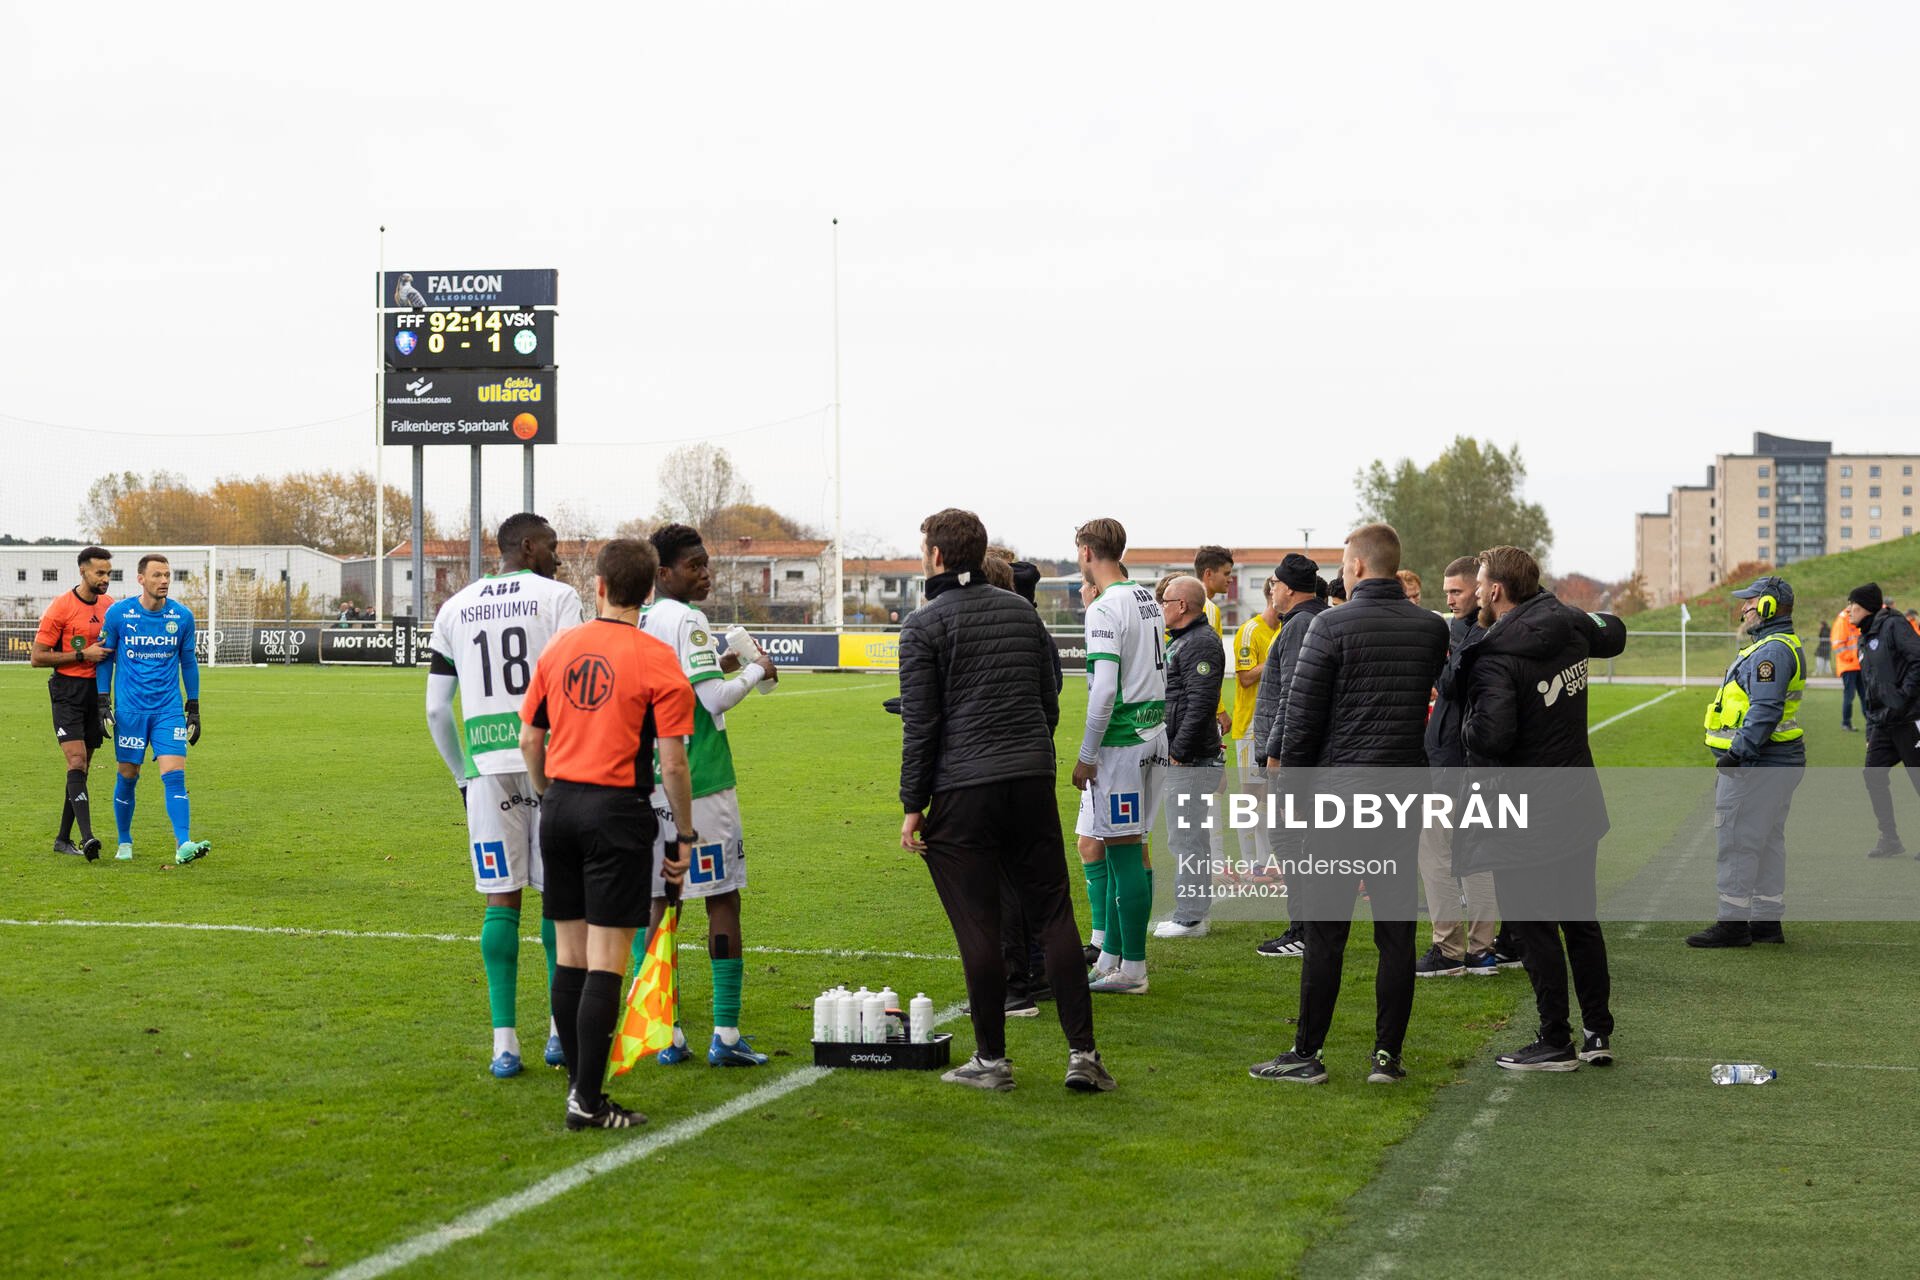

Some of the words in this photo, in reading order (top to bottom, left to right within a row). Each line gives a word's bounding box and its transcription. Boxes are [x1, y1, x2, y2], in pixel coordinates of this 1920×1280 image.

[428, 275, 502, 293] FALCON
[397, 315, 425, 328] FFF
[429, 311, 502, 332] 92:14
[504, 313, 535, 326] VSK
[428, 333, 445, 353] 0
[488, 332, 501, 352] 1
[478, 384, 541, 402] Ullared
[391, 420, 455, 434] Falkenbergs
[458, 419, 509, 434] Sparbank
[480, 581, 521, 597] ABB
[461, 600, 538, 624] NSABIYUMVA
[125, 636, 178, 646] HITACHI
[333, 637, 364, 648] MOT
[395, 626, 405, 664] SELECT
[473, 626, 531, 697] 18
[568, 659, 609, 705] MG
[470, 722, 520, 746] MOCCA
